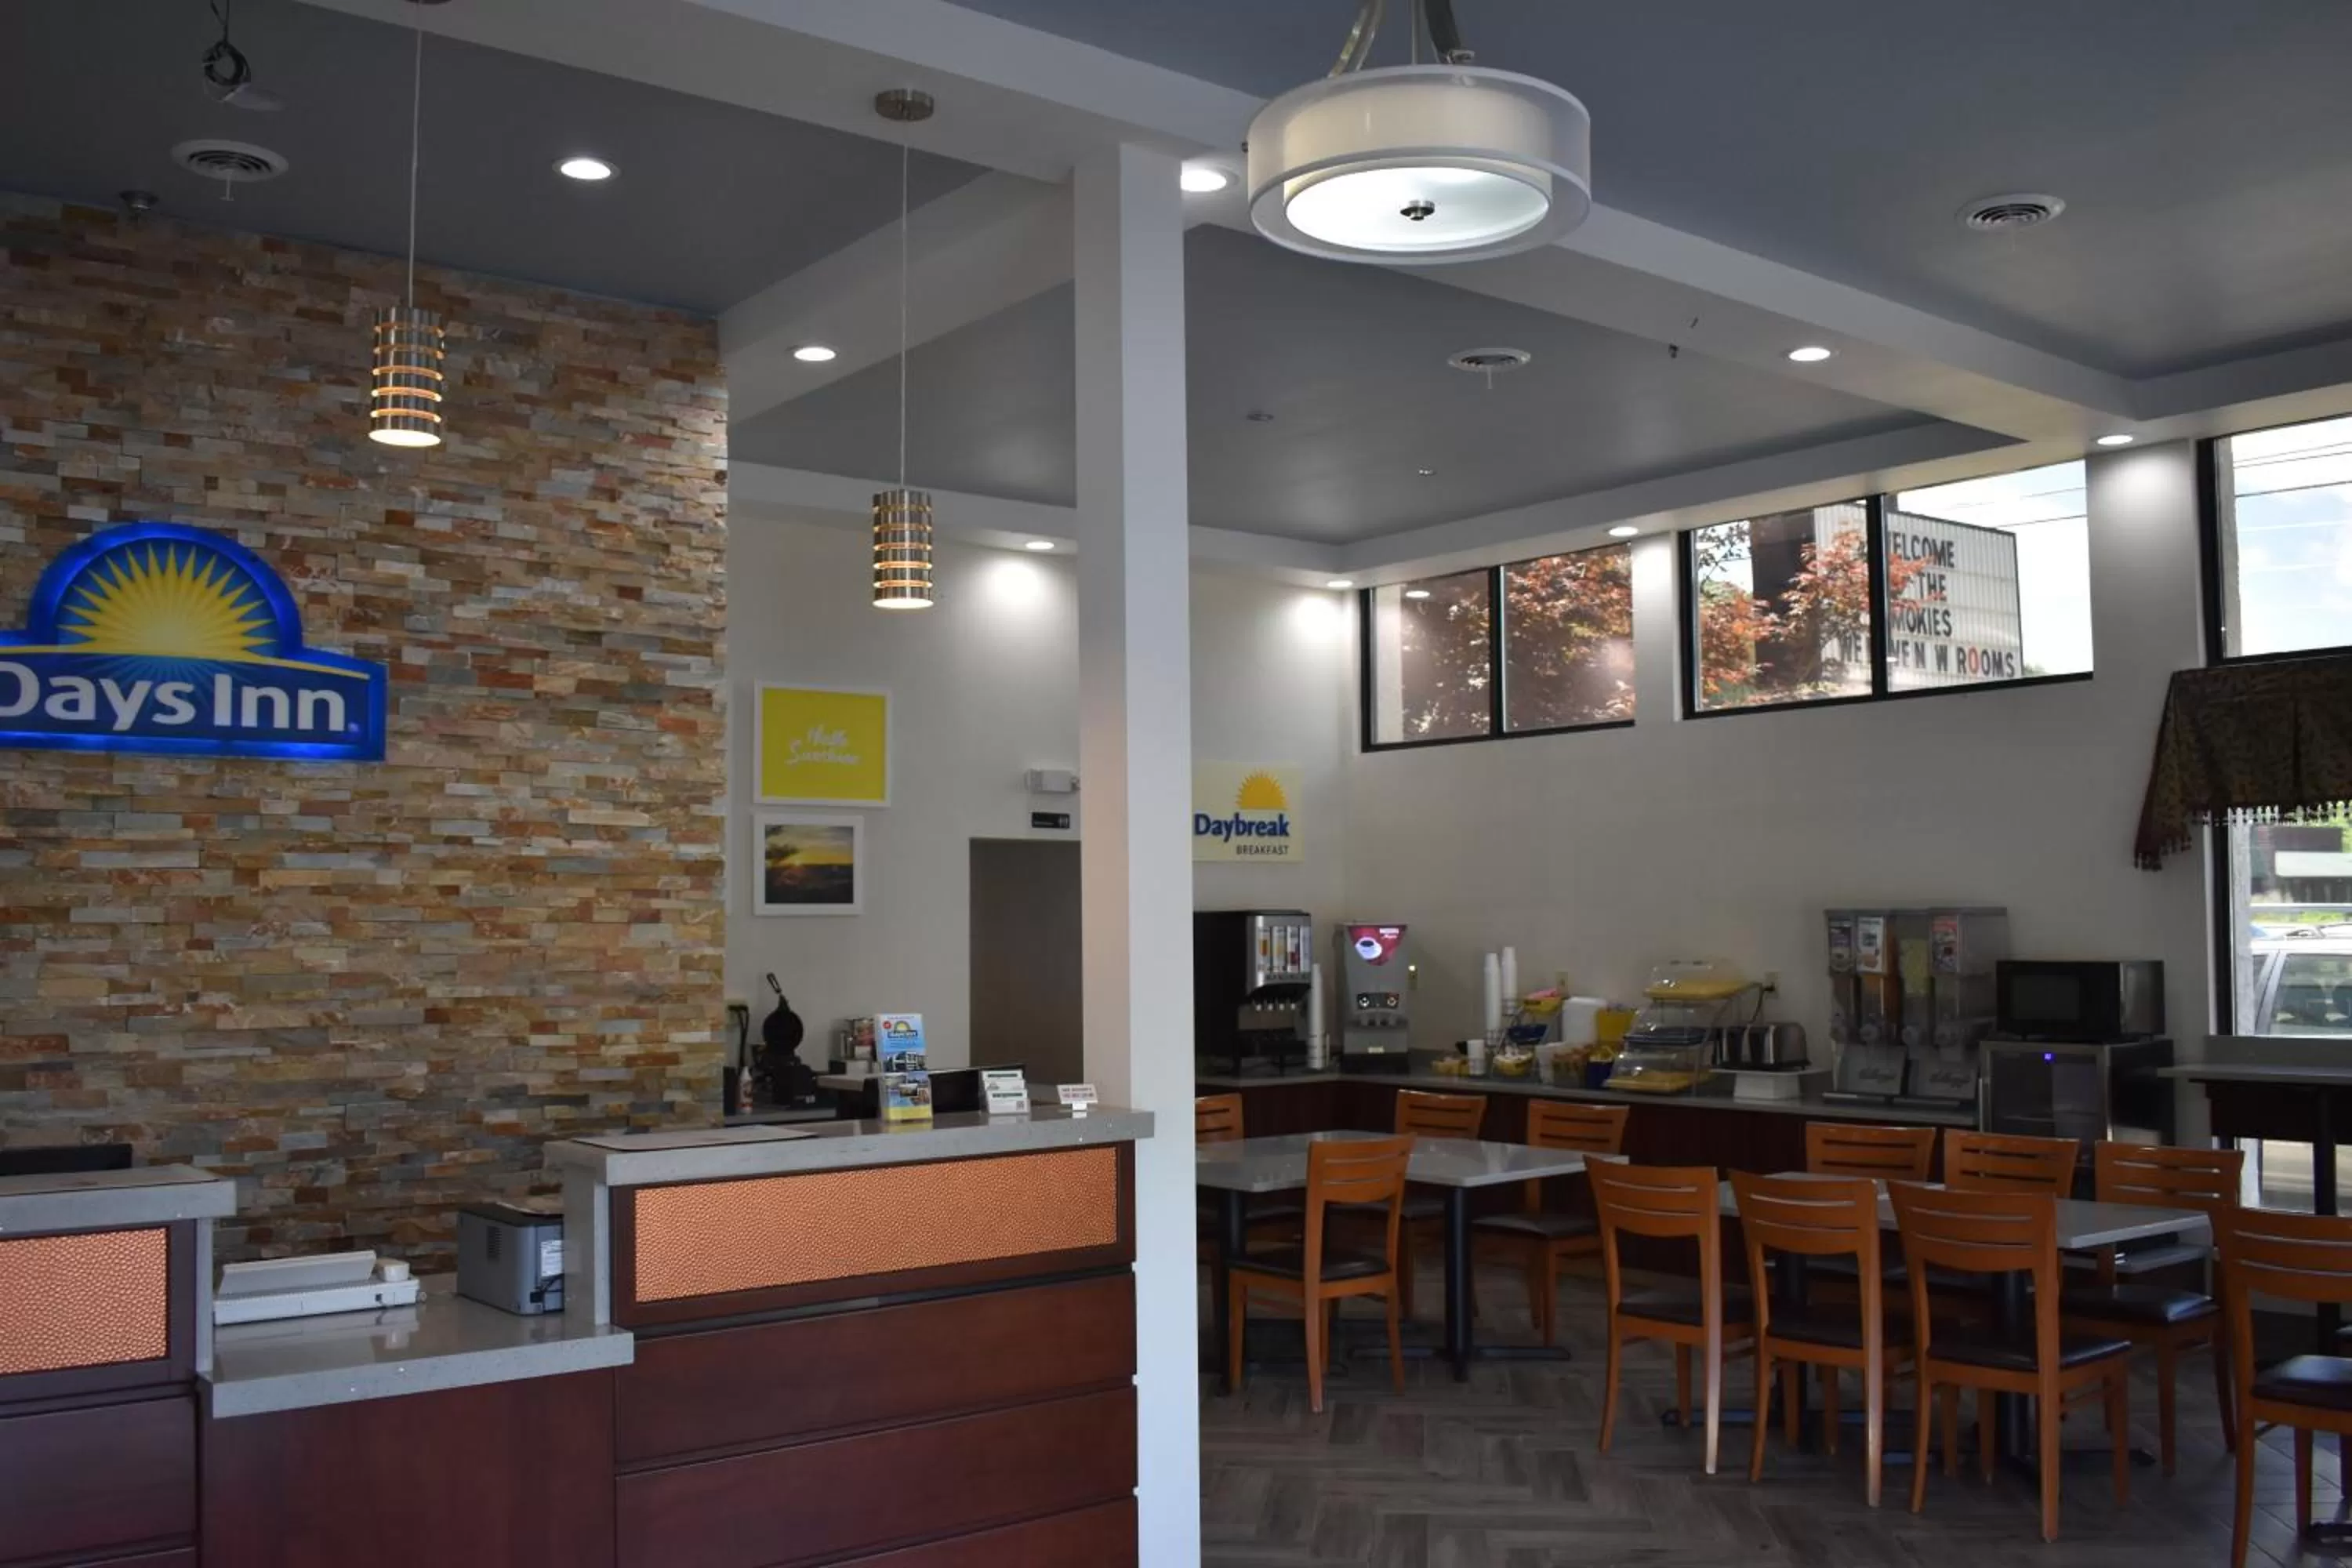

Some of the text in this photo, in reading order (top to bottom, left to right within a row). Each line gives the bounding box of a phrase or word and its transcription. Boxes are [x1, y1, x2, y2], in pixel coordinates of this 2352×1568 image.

[1919, 572, 1947, 601] THE
[1957, 645, 2015, 678] ROOMS
[0, 661, 346, 731] Days Inn
[1194, 811, 1290, 843] Daybreak
[1236, 845, 1289, 855] BREAKFAST
